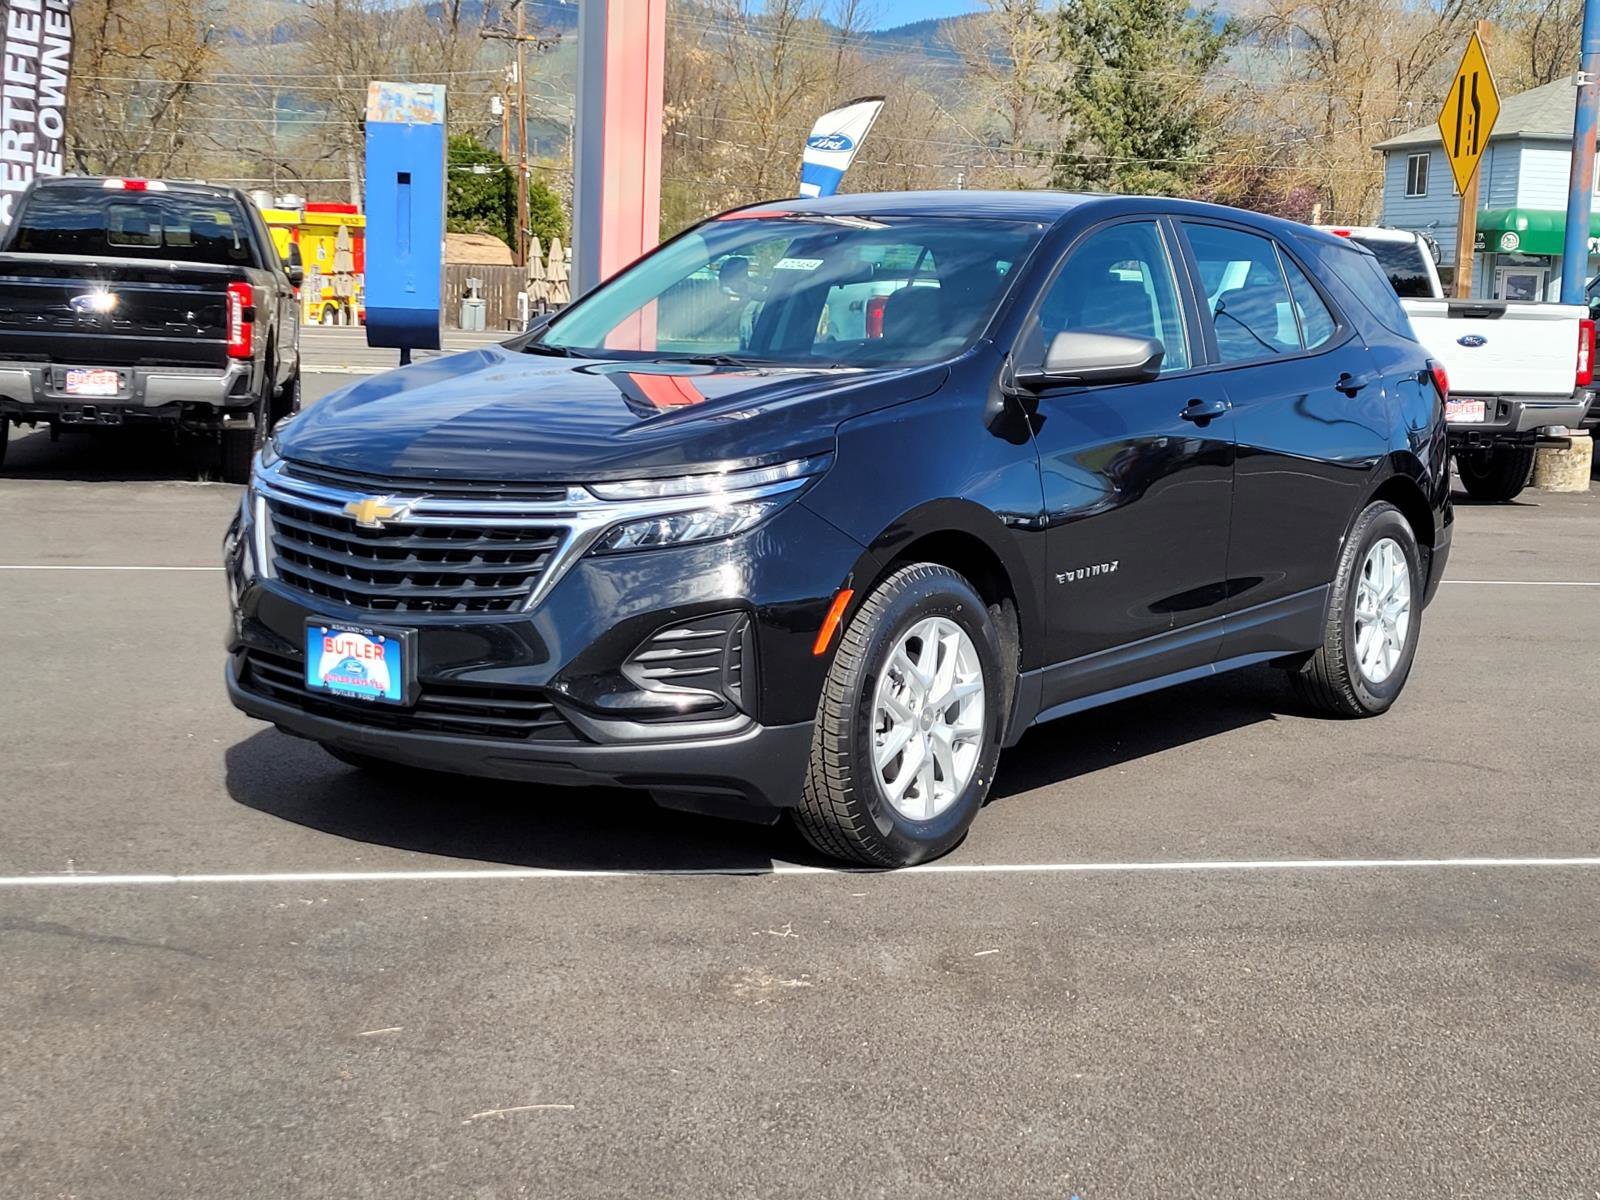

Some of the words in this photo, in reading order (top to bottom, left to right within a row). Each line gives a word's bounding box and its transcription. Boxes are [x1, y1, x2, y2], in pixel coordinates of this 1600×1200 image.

[810, 134, 846, 150] Ford
[1055, 560, 1119, 584] EQUINOX
[324, 637, 385, 661] BUTLER
